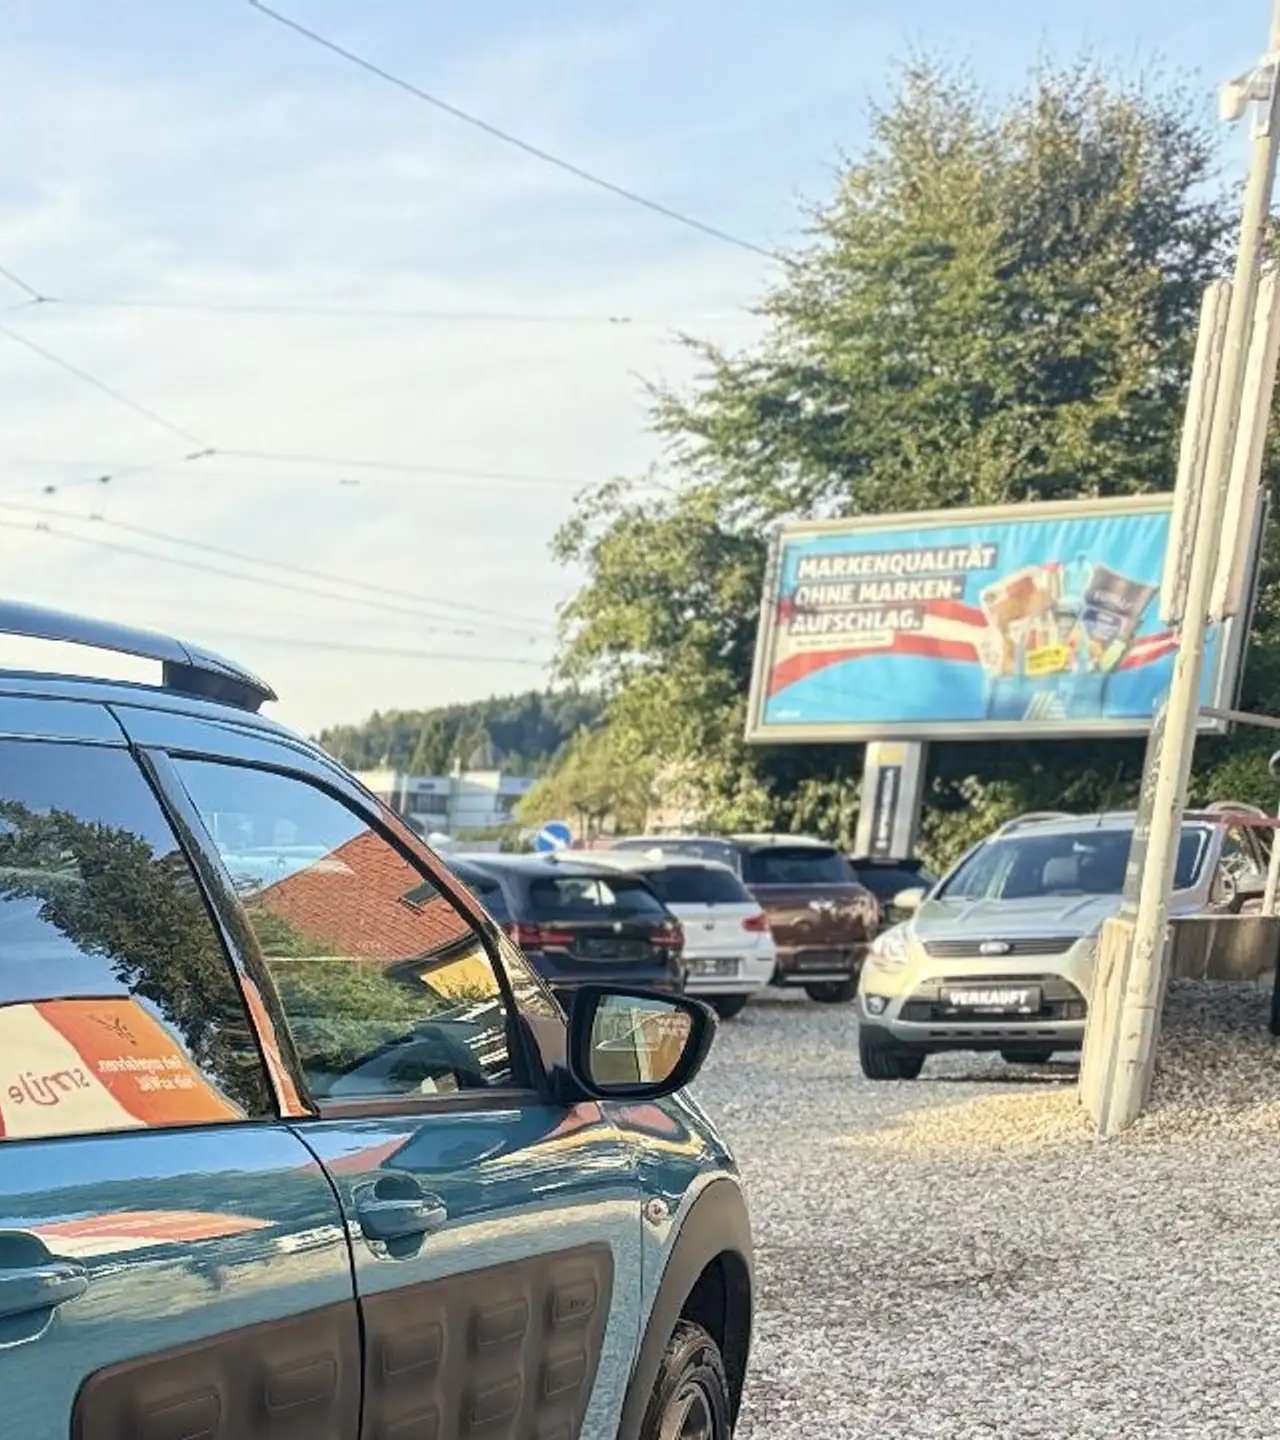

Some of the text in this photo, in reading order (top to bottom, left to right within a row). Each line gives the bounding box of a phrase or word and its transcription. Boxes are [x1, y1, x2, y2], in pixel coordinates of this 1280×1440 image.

[798, 546, 995, 579] MARKENQUALITÄT
[795, 578, 962, 606] OHNE MARKEN-
[791, 609, 921, 634] AUFSCHLAG.
[950, 989, 1029, 1005] VERKAUFT
